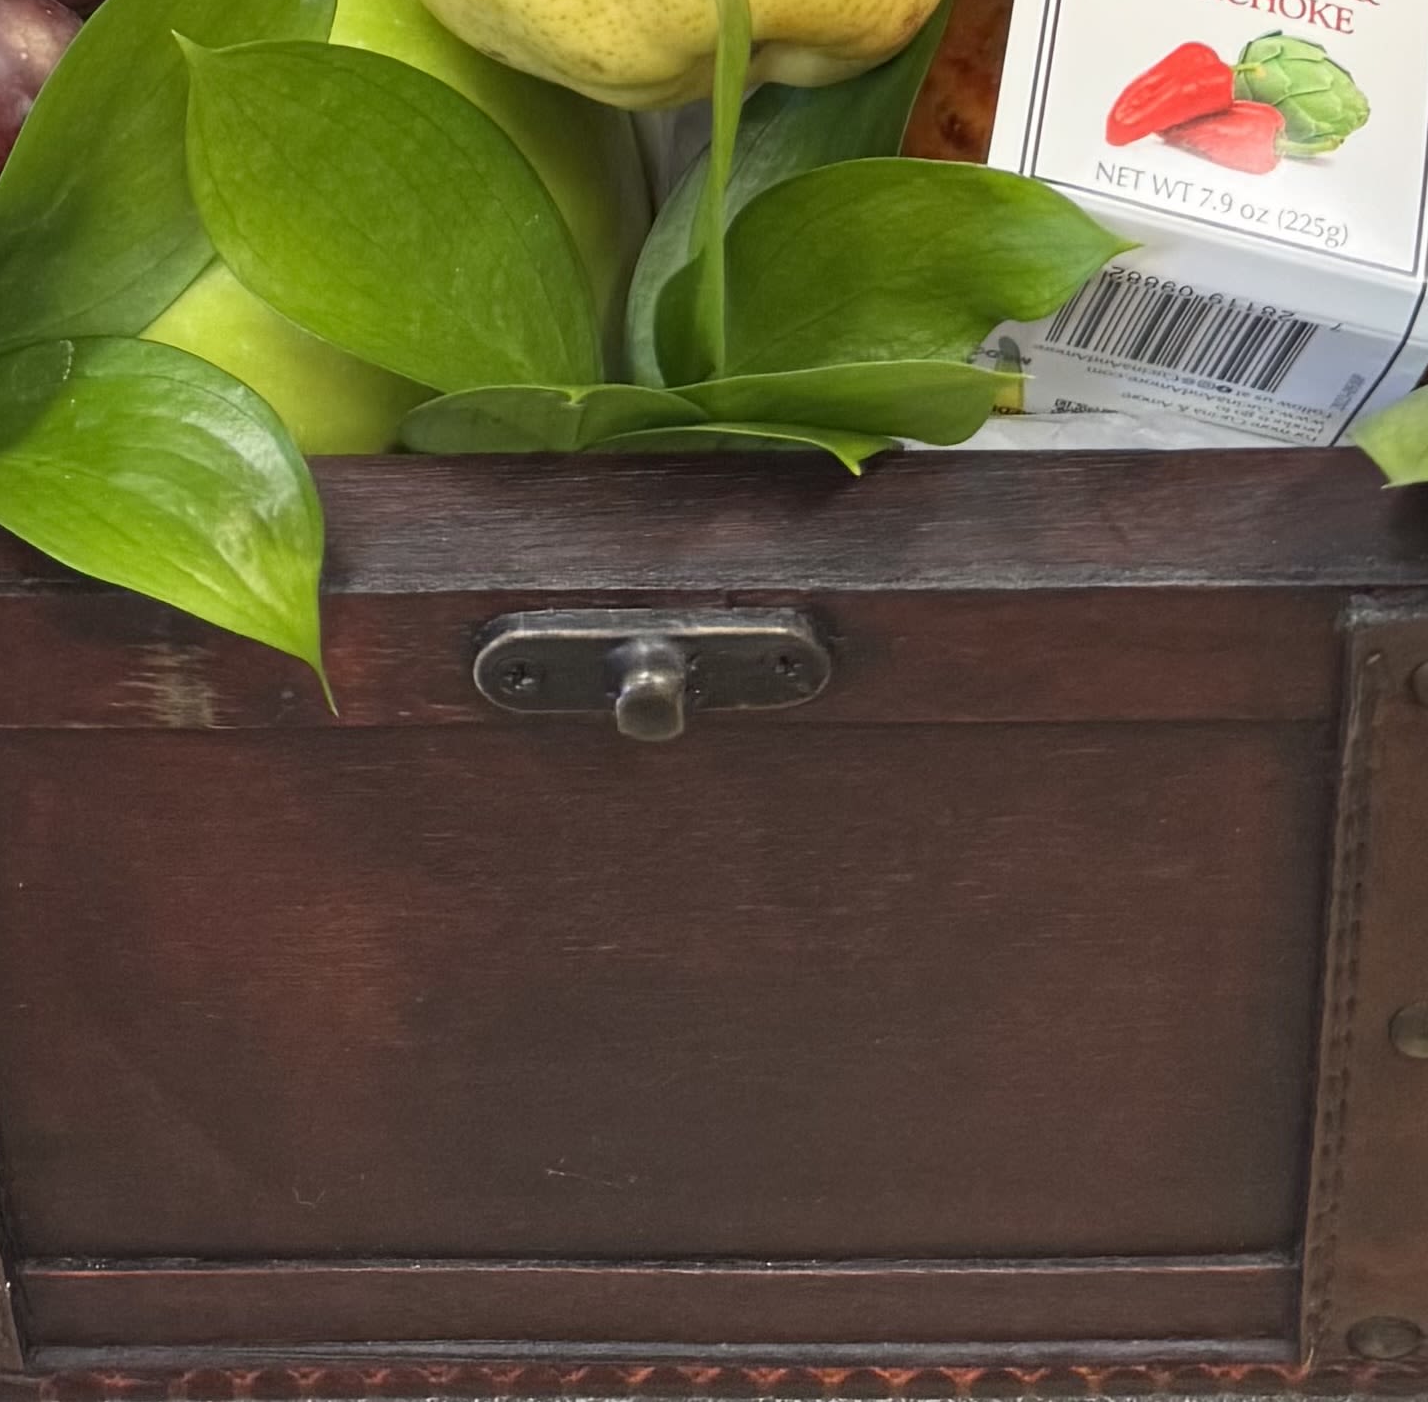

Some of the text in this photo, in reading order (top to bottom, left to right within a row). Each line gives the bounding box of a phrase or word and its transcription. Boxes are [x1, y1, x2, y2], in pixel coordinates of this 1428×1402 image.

[1095, 161, 1349, 248] NET WT 7.9 oz (225g)
